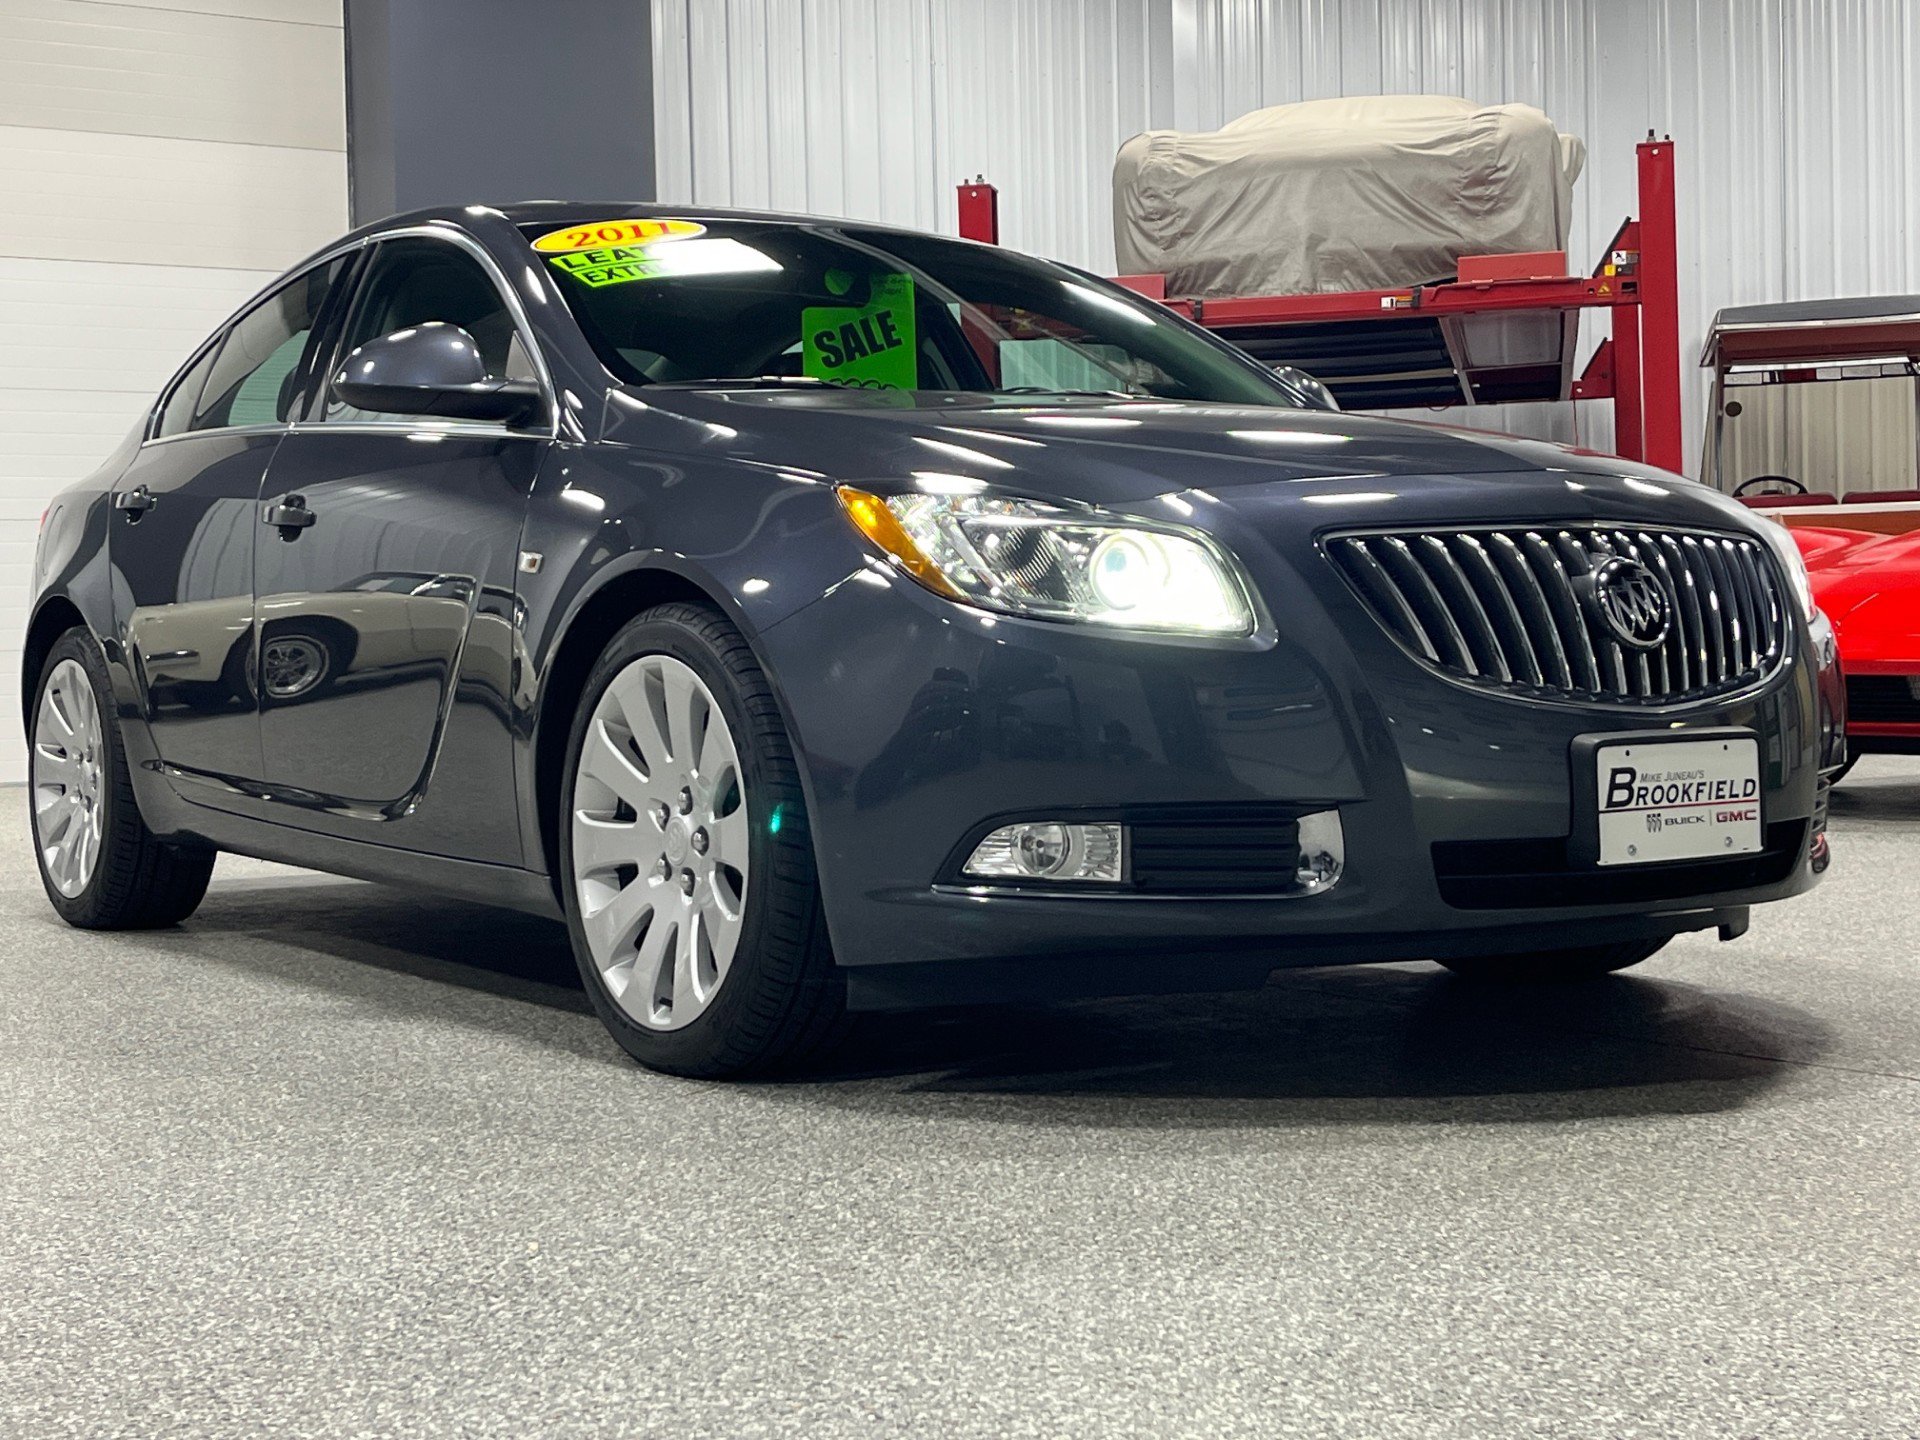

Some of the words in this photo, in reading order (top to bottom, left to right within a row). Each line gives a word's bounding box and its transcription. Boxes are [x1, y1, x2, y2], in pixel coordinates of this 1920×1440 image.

[567, 221, 674, 247] 2011
[813, 310, 903, 369] SALE
[1605, 767, 1756, 808] BROOKFIELD
[1664, 814, 1706, 826] BUICK
[1716, 809, 1757, 823] GMC
